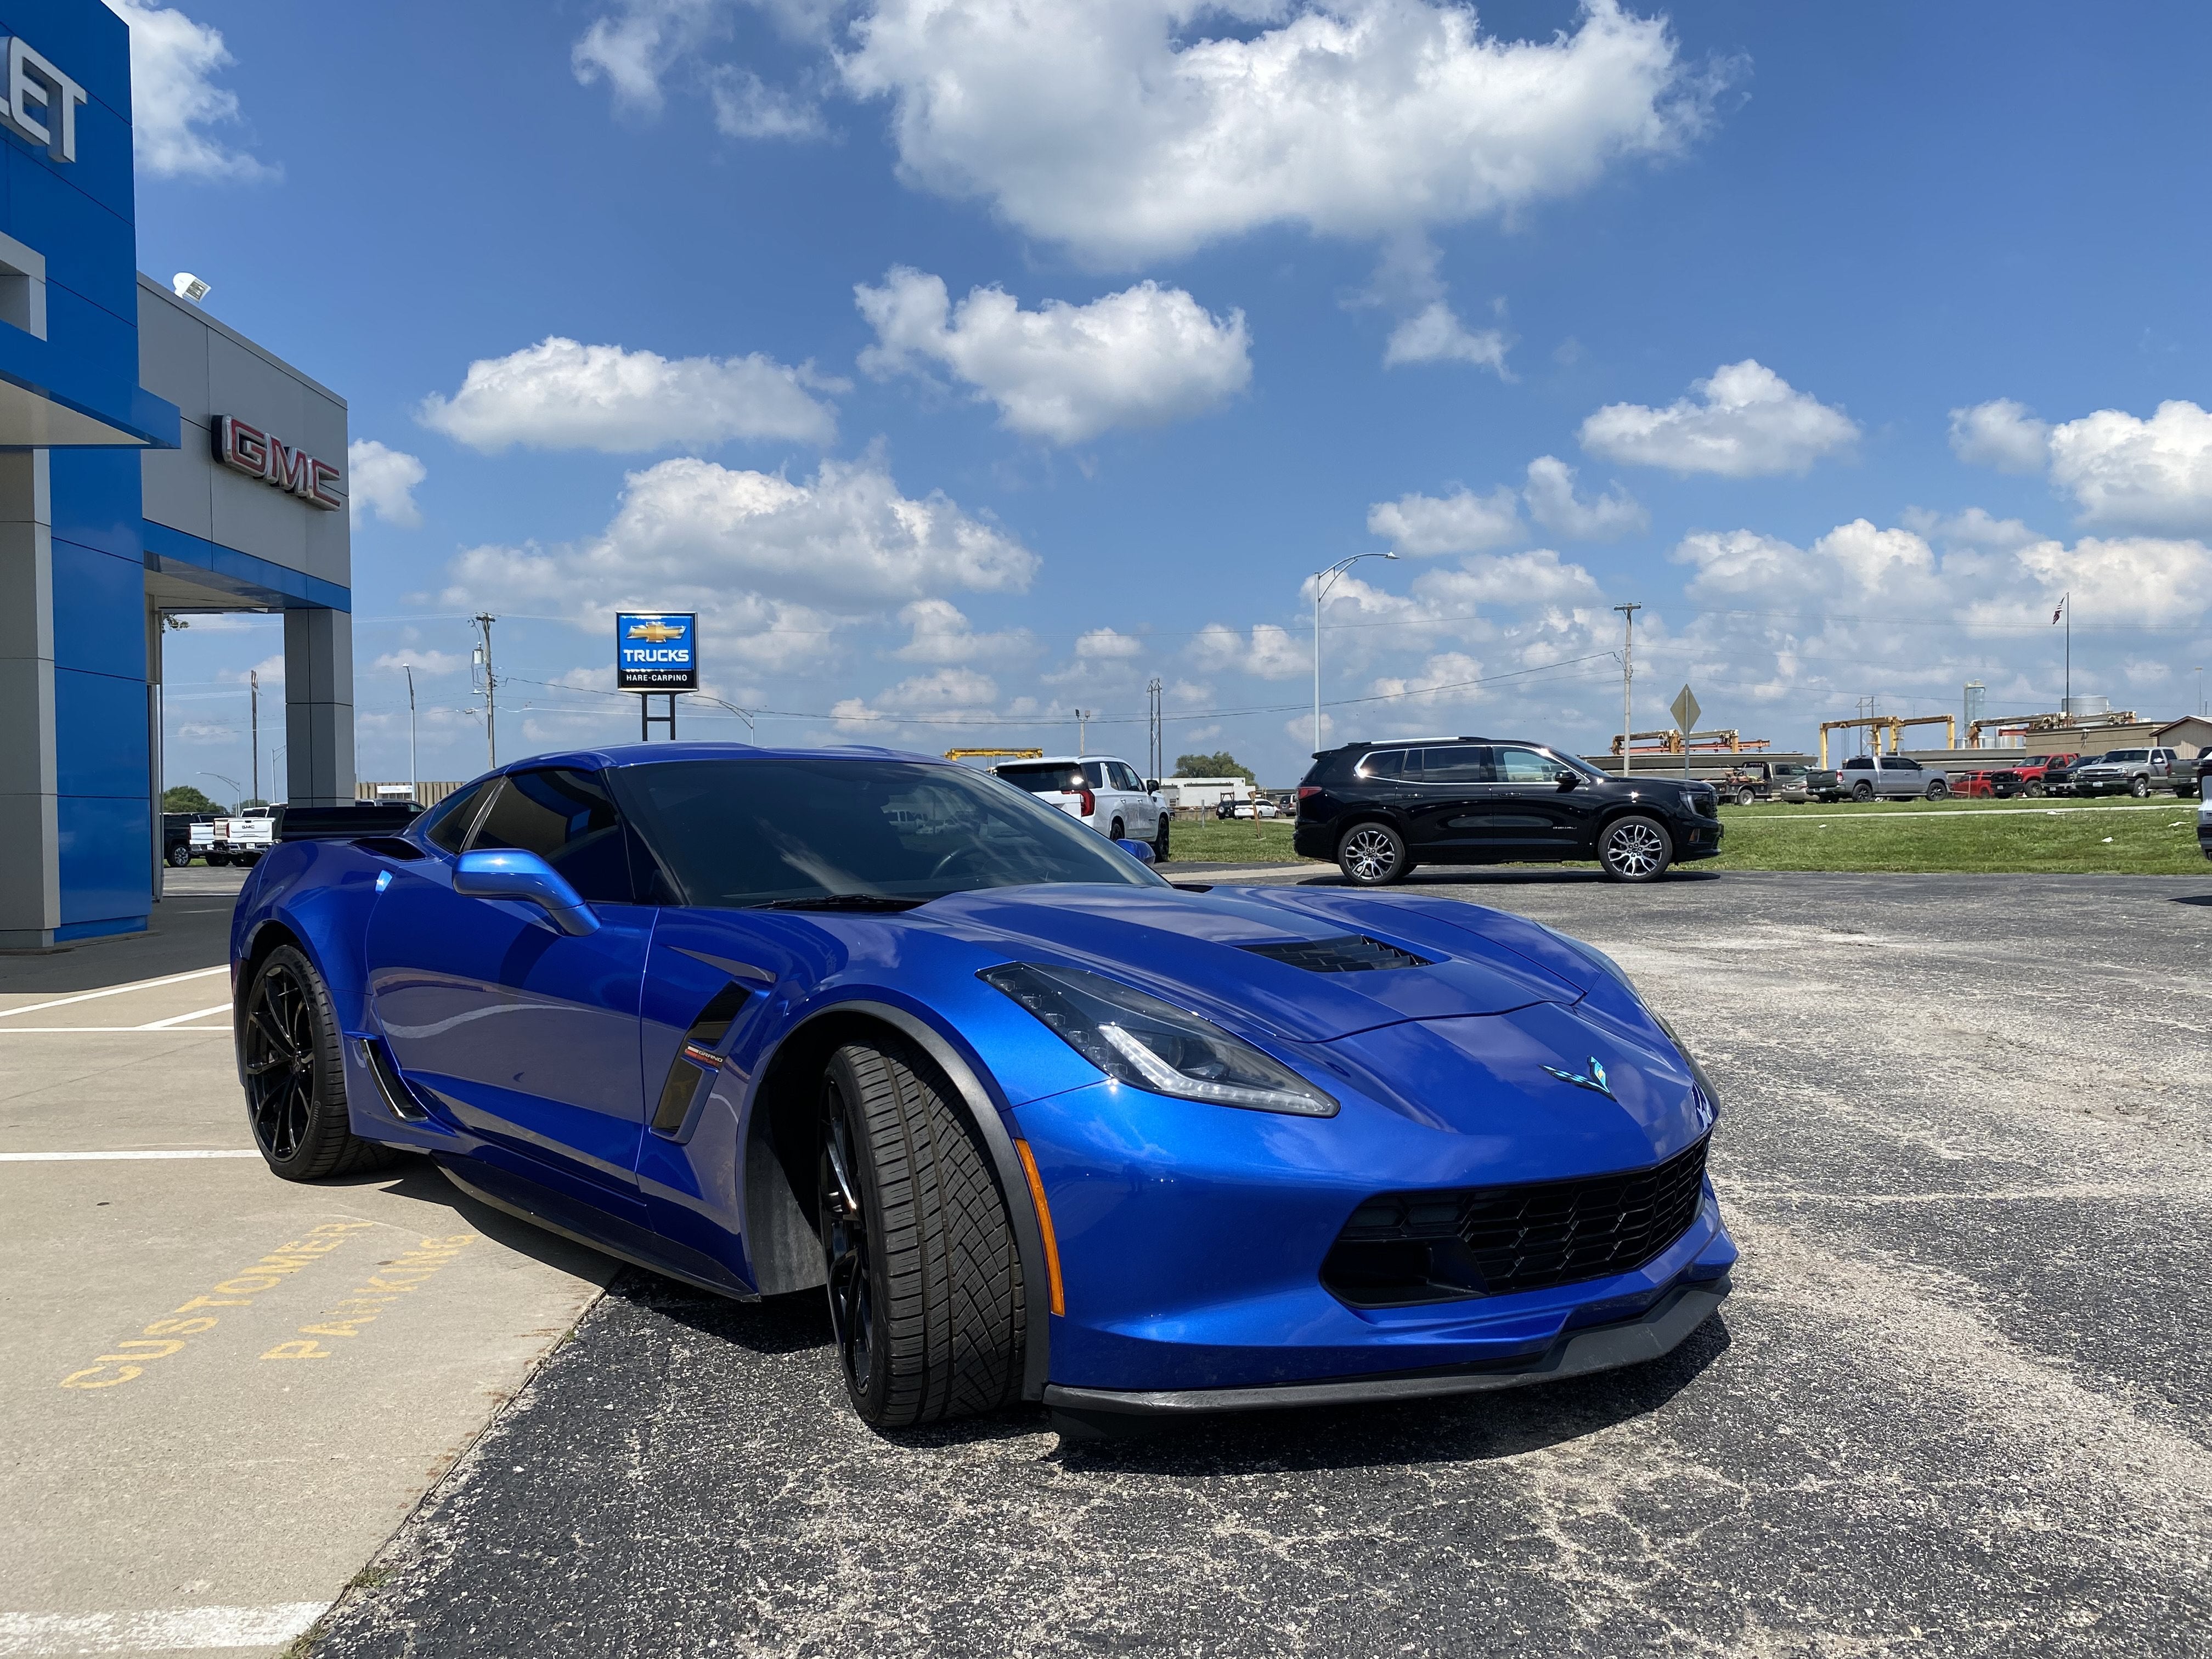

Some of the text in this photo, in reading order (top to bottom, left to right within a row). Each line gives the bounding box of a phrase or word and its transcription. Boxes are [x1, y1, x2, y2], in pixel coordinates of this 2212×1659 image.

[215, 414, 341, 511] GMC
[623, 650, 689, 662] TRUCKS
[699, 1051, 723, 1063] GRAND
[59, 1222, 374, 1389] CUSTOMER
[259, 1235, 479, 1359] PARKING
